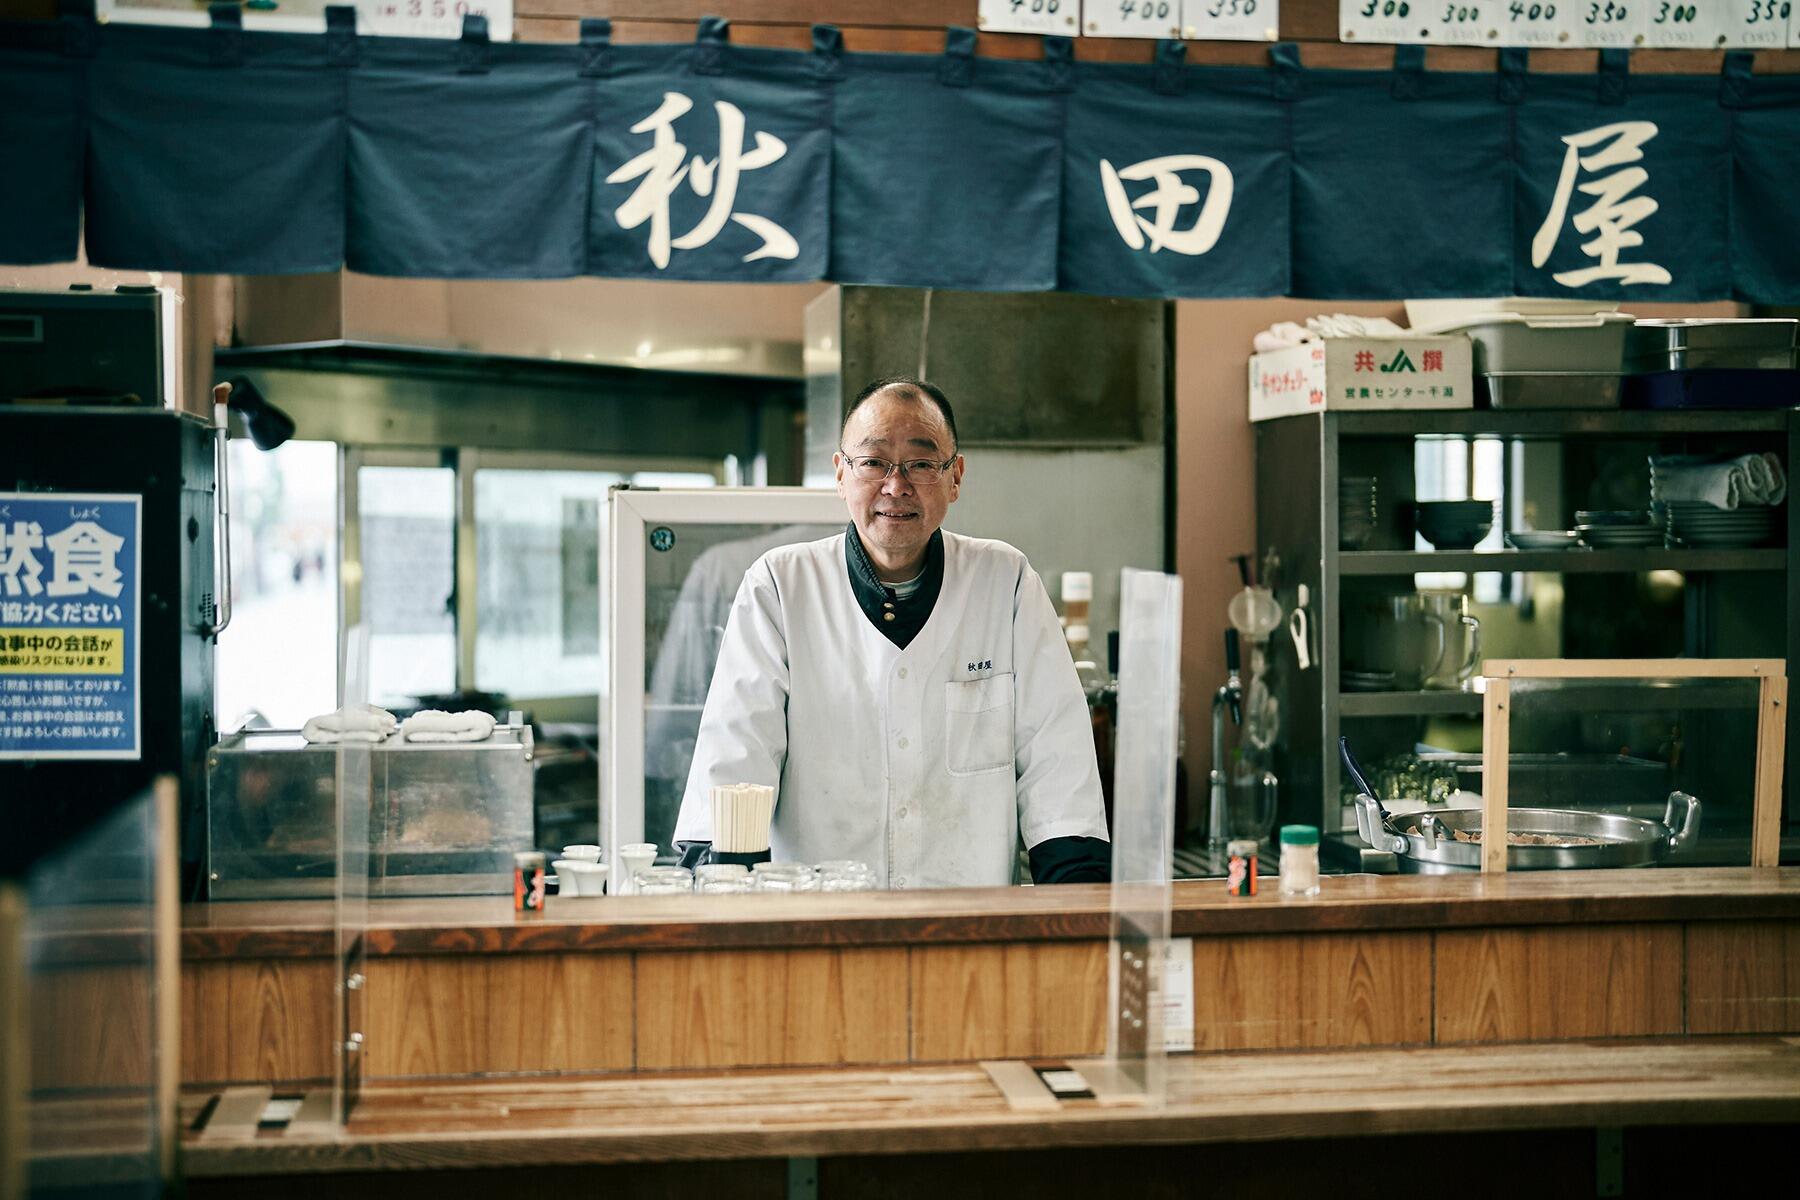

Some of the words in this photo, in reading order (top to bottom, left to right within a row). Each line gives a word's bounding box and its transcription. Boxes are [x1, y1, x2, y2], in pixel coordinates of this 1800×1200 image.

[1119, 0, 1169, 20] 400
[1361, 0, 1410, 18] 300
[1441, 5, 1479, 23] 300
[1508, 0, 1557, 22] 400
[1585, 1, 1627, 23] 350
[1653, 1, 1697, 23] 300
[1746, 0, 1791, 23] 350
[1354, 350, 1375, 372] 共
[0, 602, 122, 623] 協力ください
